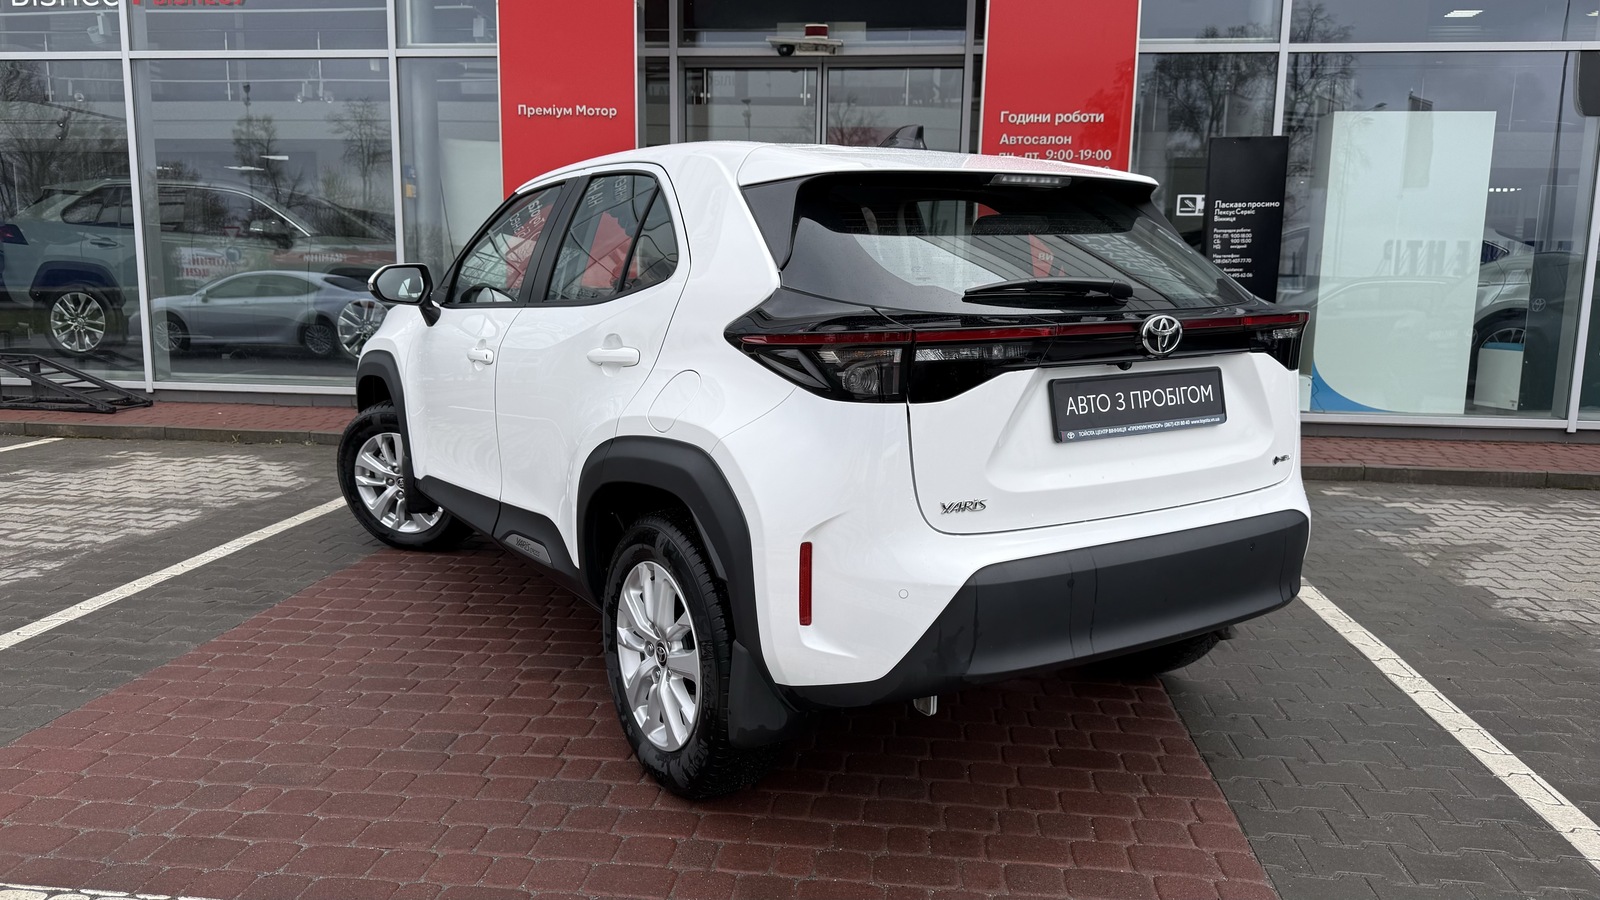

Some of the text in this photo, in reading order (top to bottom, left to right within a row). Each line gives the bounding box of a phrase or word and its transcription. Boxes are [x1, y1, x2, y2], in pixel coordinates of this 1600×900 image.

[517, 104, 617, 119] Преміум Мотор
[1000, 110, 1105, 125] Години роботи
[1000, 133, 1072, 145] Автосалон
[1214, 200, 1280, 209] Ласкаво просимо
[1066, 384, 1213, 416] АВТО З ПРОБІГОМ
